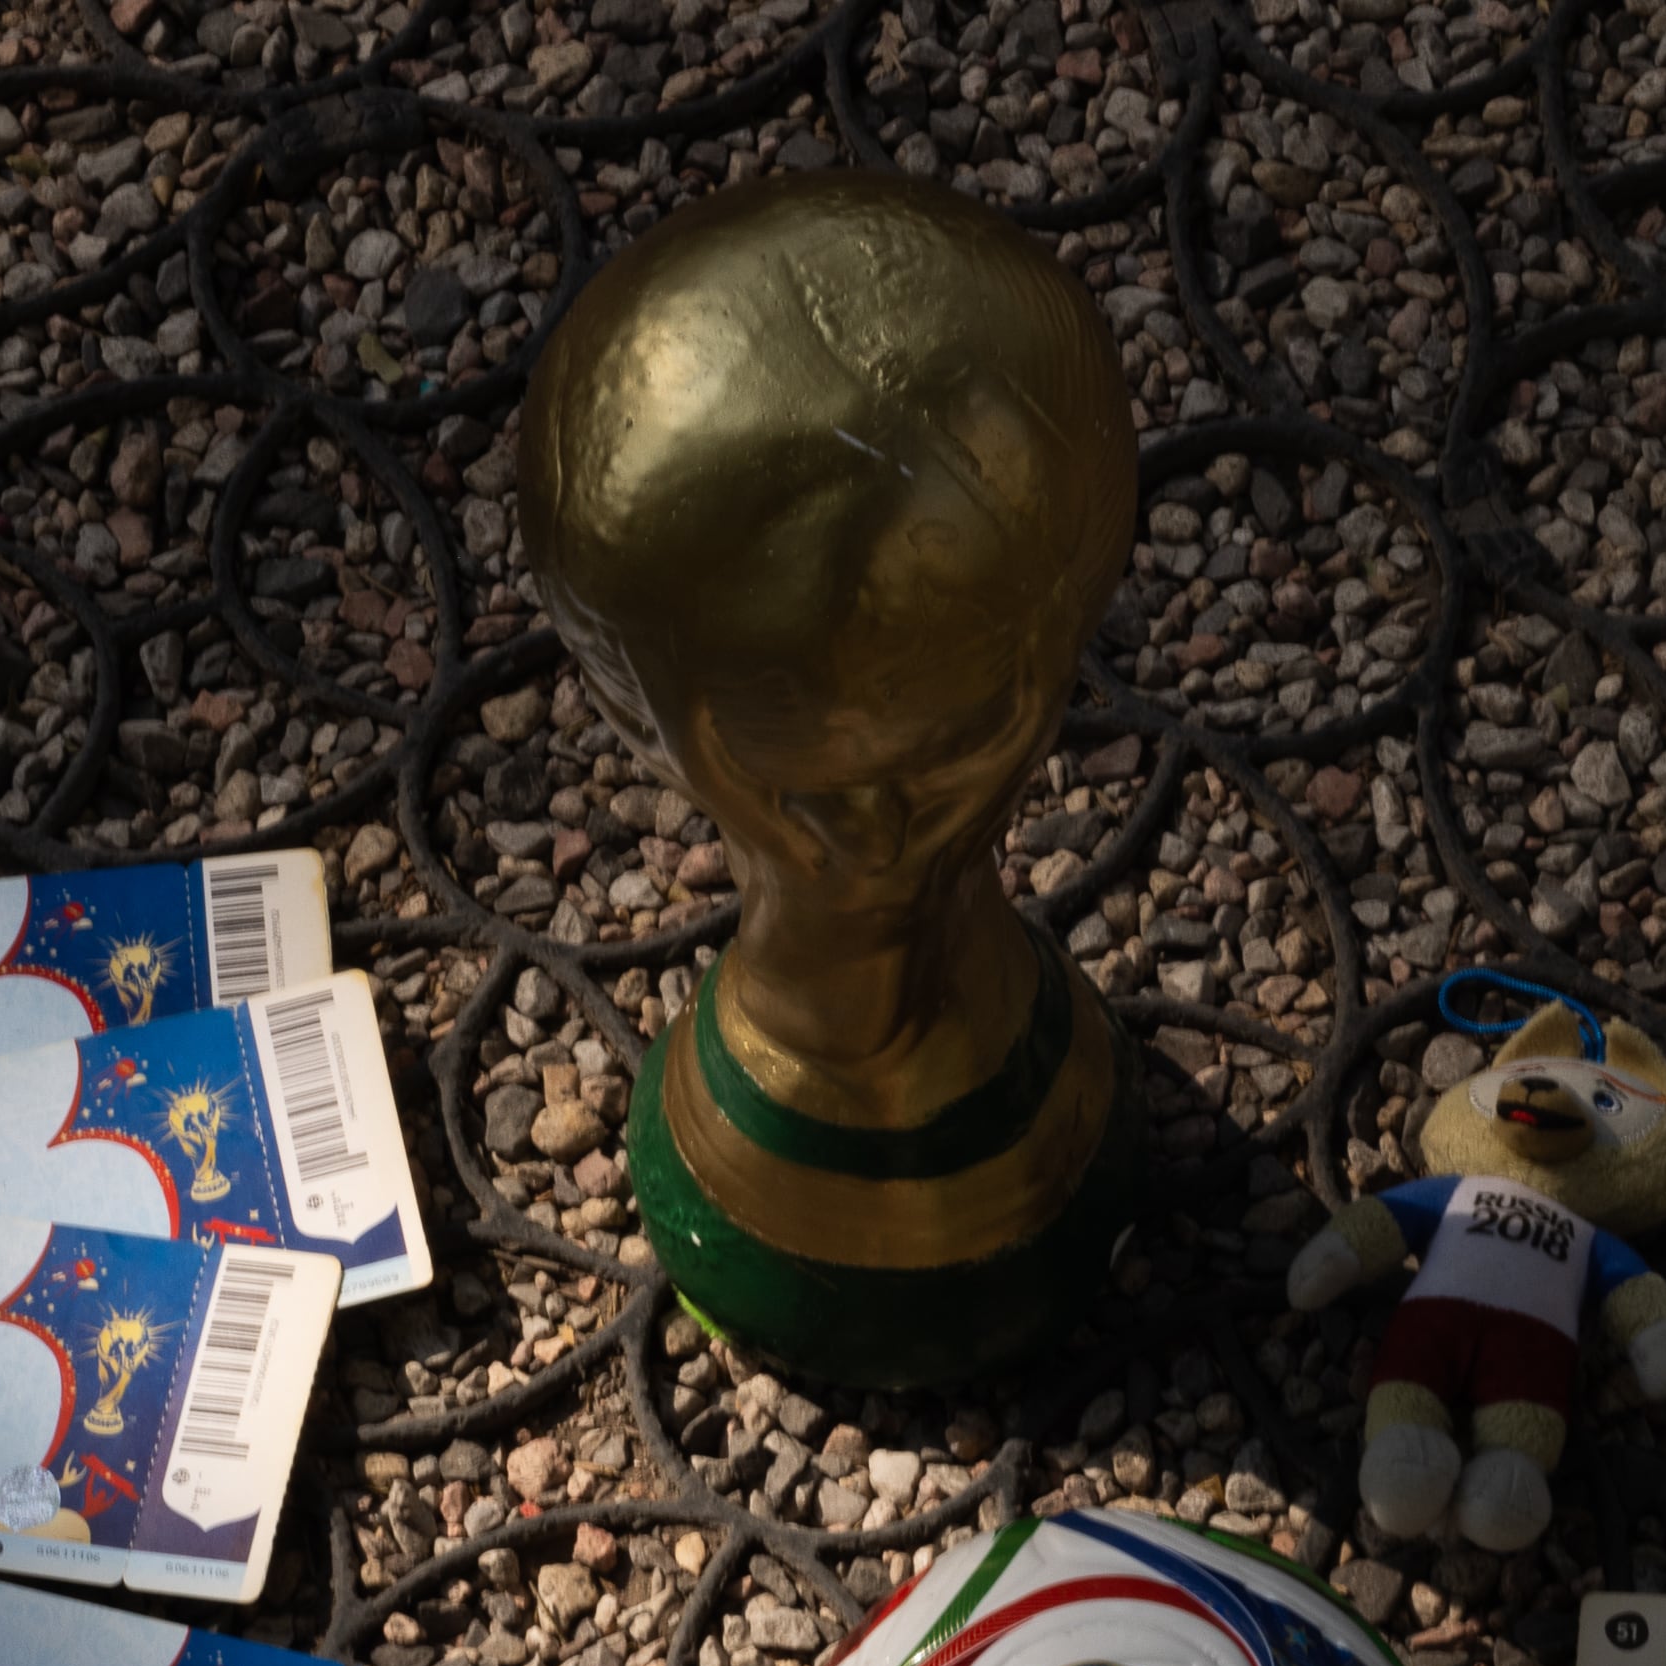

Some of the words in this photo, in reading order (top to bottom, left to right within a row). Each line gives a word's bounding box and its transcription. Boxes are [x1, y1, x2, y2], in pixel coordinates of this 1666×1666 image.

[1466, 1209, 1569, 1264] 2018
[1474, 1191, 1575, 1239] RUSSIA
[1617, 1622, 1639, 1642] 51
